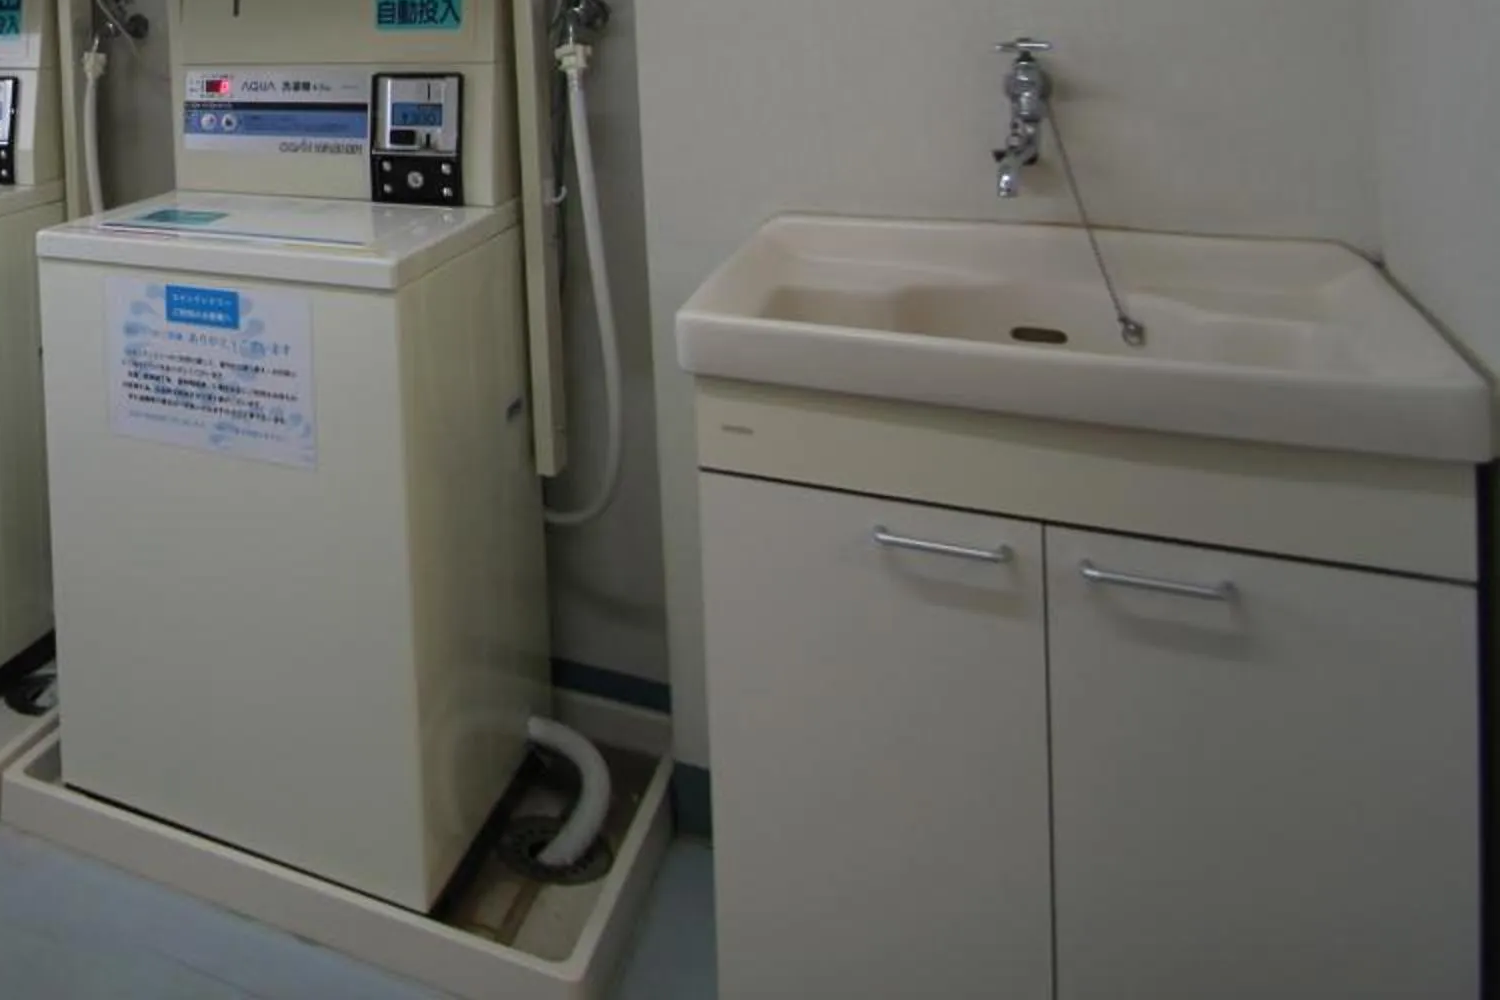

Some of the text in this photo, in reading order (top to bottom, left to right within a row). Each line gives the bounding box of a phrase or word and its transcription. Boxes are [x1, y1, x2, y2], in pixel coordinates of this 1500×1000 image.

[376, 0, 461, 26] 自動投入
[241, 81, 276, 93] AQUA
